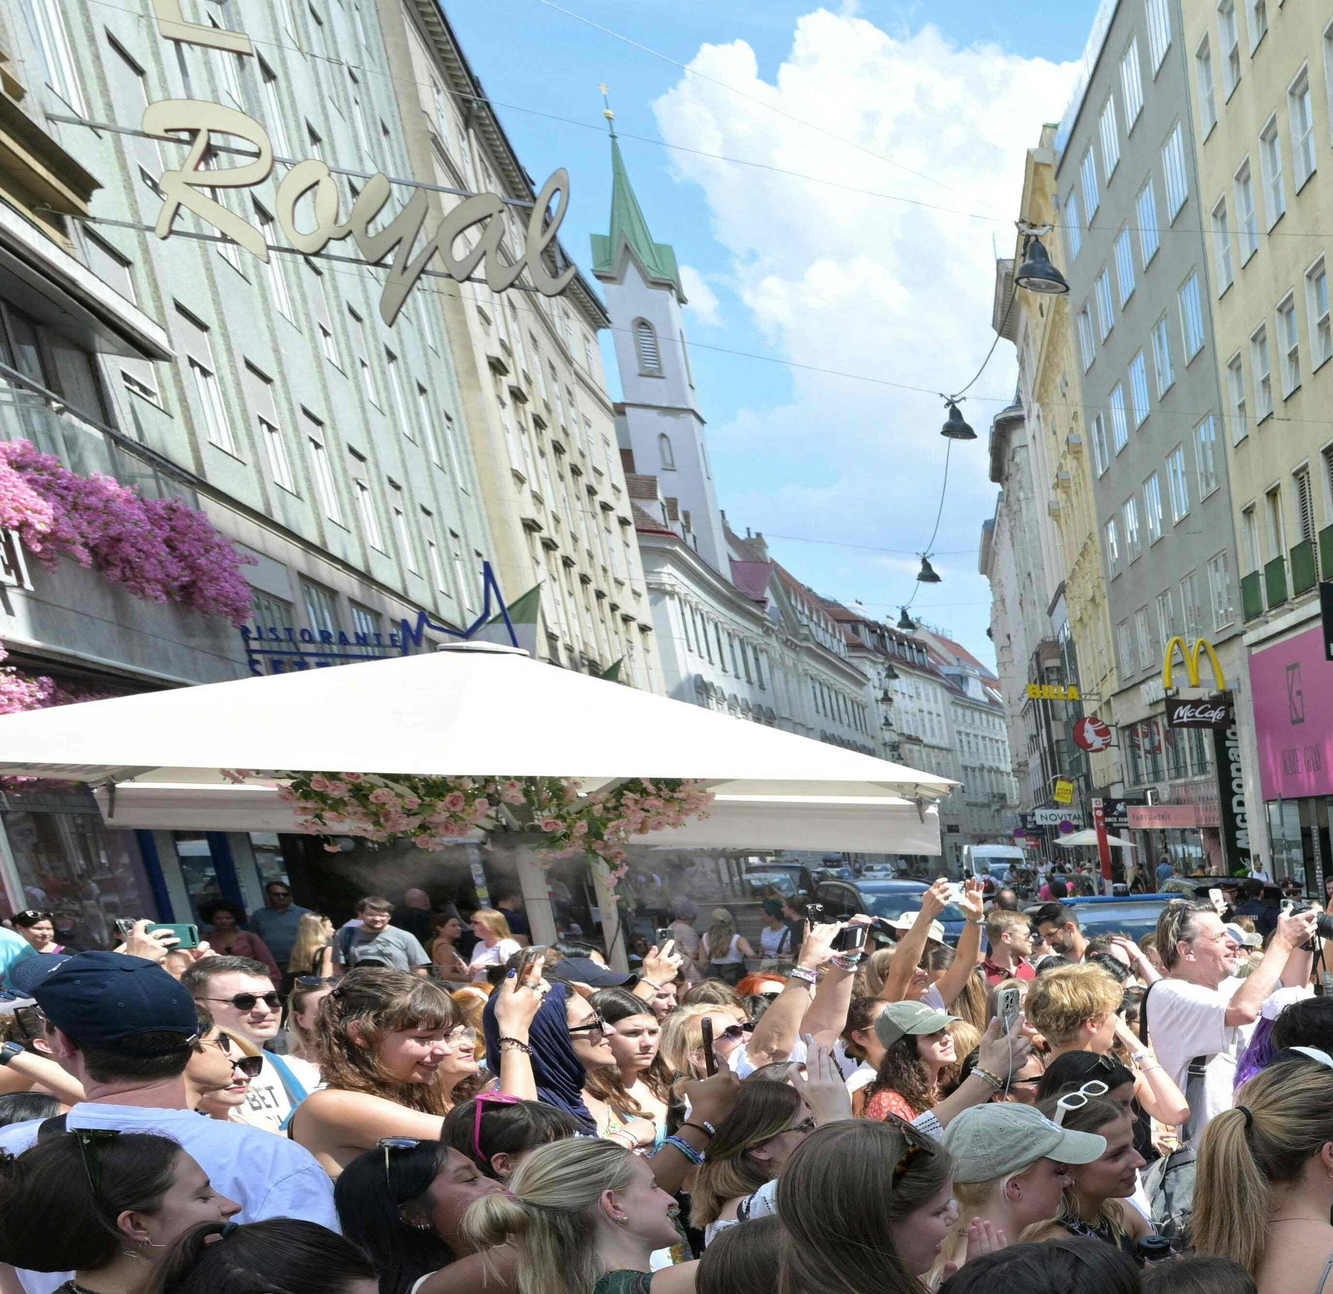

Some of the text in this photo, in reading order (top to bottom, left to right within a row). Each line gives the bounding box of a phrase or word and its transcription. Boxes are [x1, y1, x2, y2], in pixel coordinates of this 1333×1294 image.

[143, 99, 575, 327] Royal
[240, 625, 400, 648] RISTORANTE
[1027, 684, 1081, 700] BILLA
